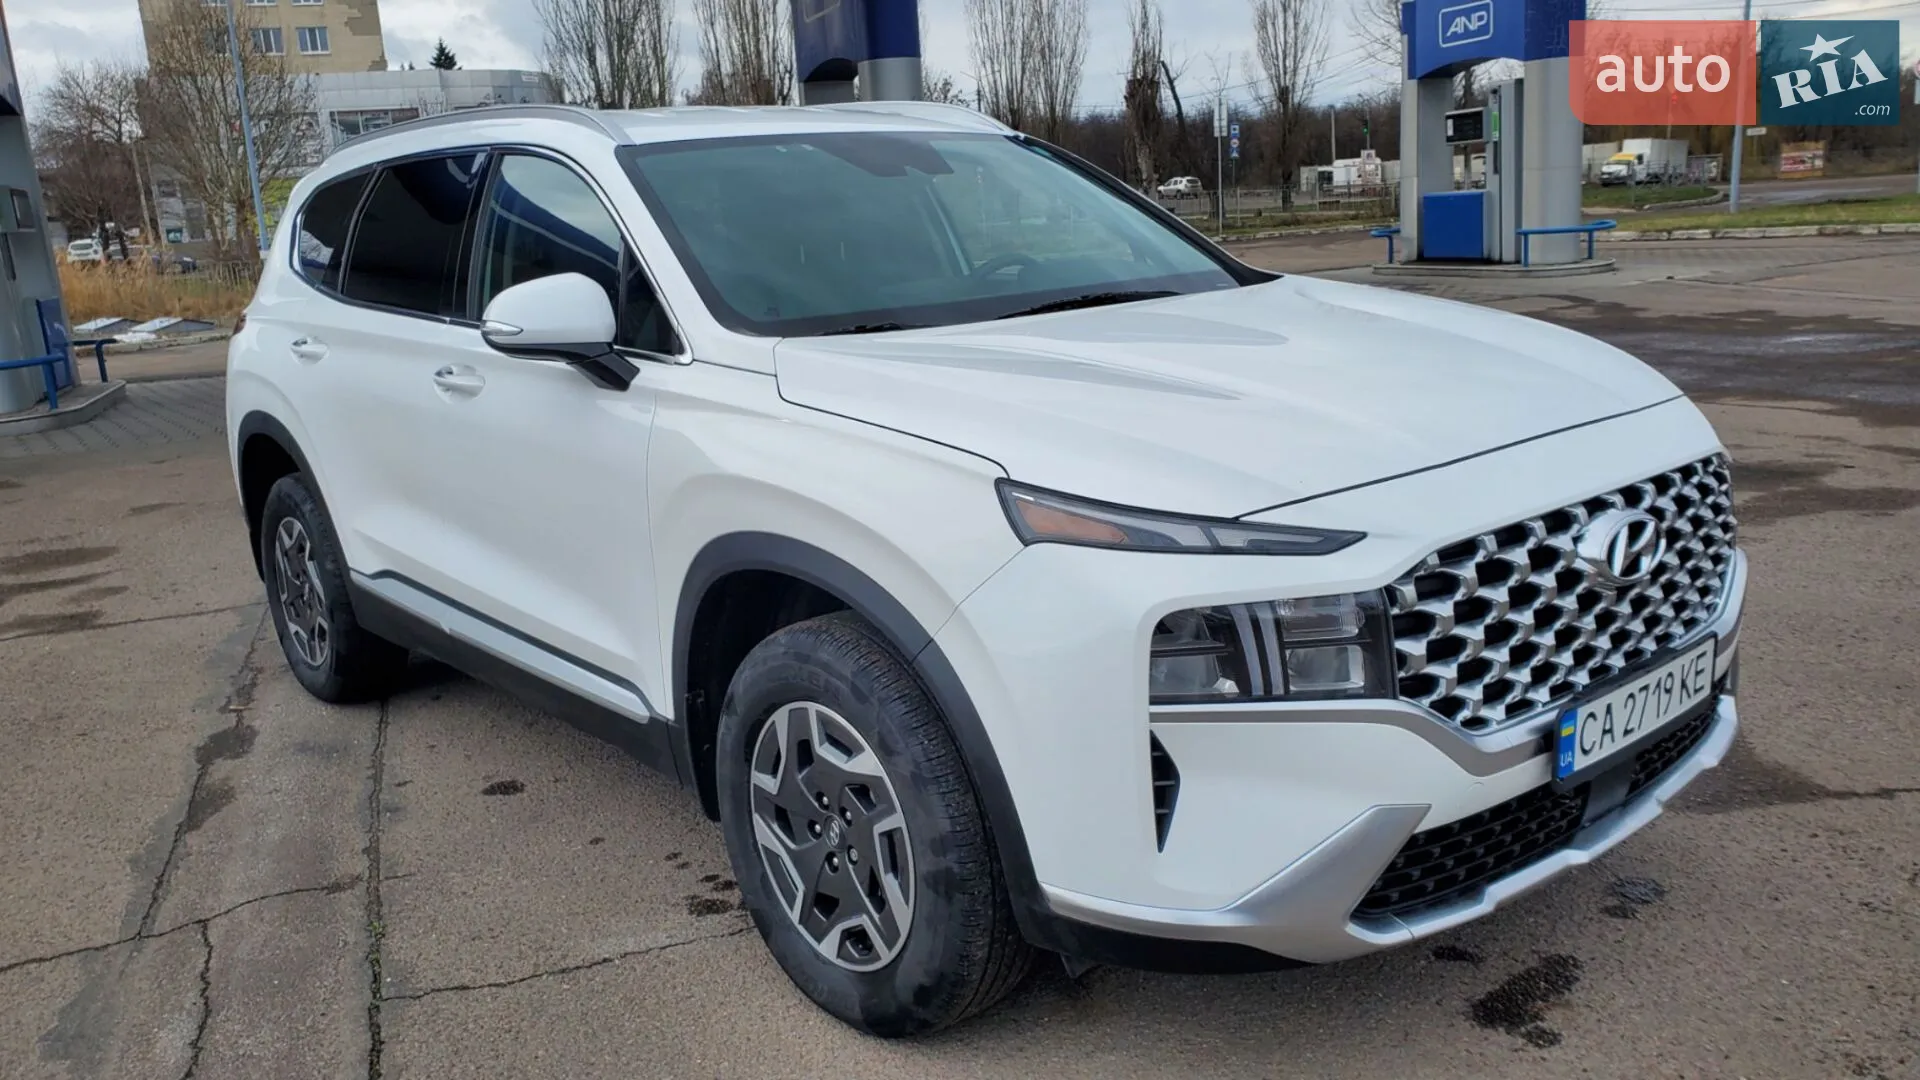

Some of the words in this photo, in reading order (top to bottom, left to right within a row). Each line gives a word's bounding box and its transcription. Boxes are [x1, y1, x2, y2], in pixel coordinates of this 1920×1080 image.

[1446, 10, 1488, 37] ANP
[1579, 702, 1615, 756] CA
[1622, 671, 1675, 738] 2719
[1679, 650, 1707, 705] KE
[1559, 751, 1573, 768] UA
